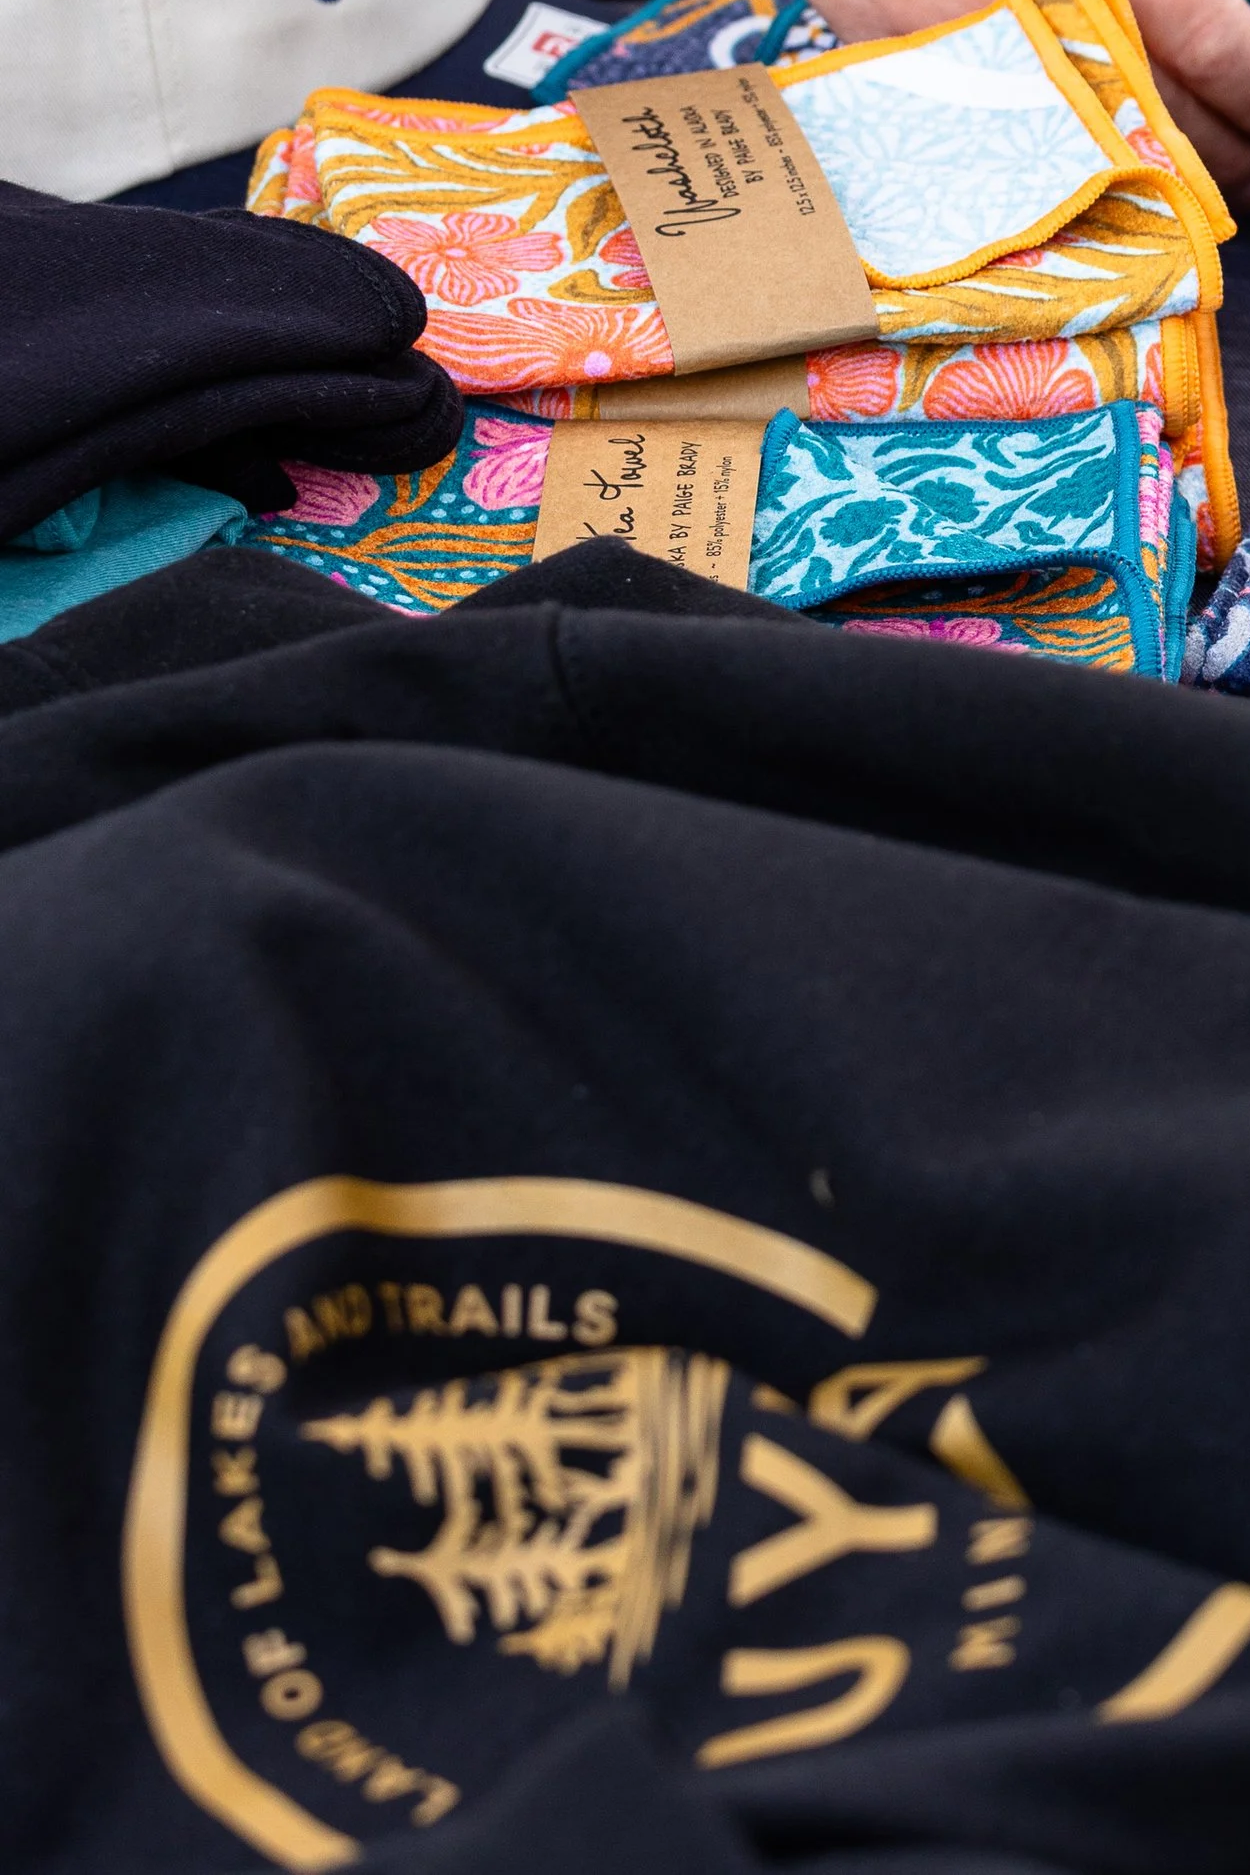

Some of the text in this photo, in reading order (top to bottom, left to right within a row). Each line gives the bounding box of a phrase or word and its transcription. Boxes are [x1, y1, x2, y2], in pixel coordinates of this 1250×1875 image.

[695, 137, 717, 150] IN
[728, 137, 756, 166] PAIGE
[621, 107, 742, 237] Washcloth
[704, 152, 740, 199] DESIGNED
[741, 170, 764, 184] BY
[582, 433, 648, 501] Towel
[676, 441, 703, 478] BRADY
[716, 455, 737, 478] nylon
[672, 482, 695, 517] PAIGE
[713, 477, 730, 494] 15%
[669, 523, 692, 541] BY
[709, 501, 731, 537] polyester
[705, 539, 723, 558] 85%
[377, 1279, 621, 1348] TRAILS
[210, 1342, 287, 1612] LAKES
[241, 1627, 325, 1722] OF
